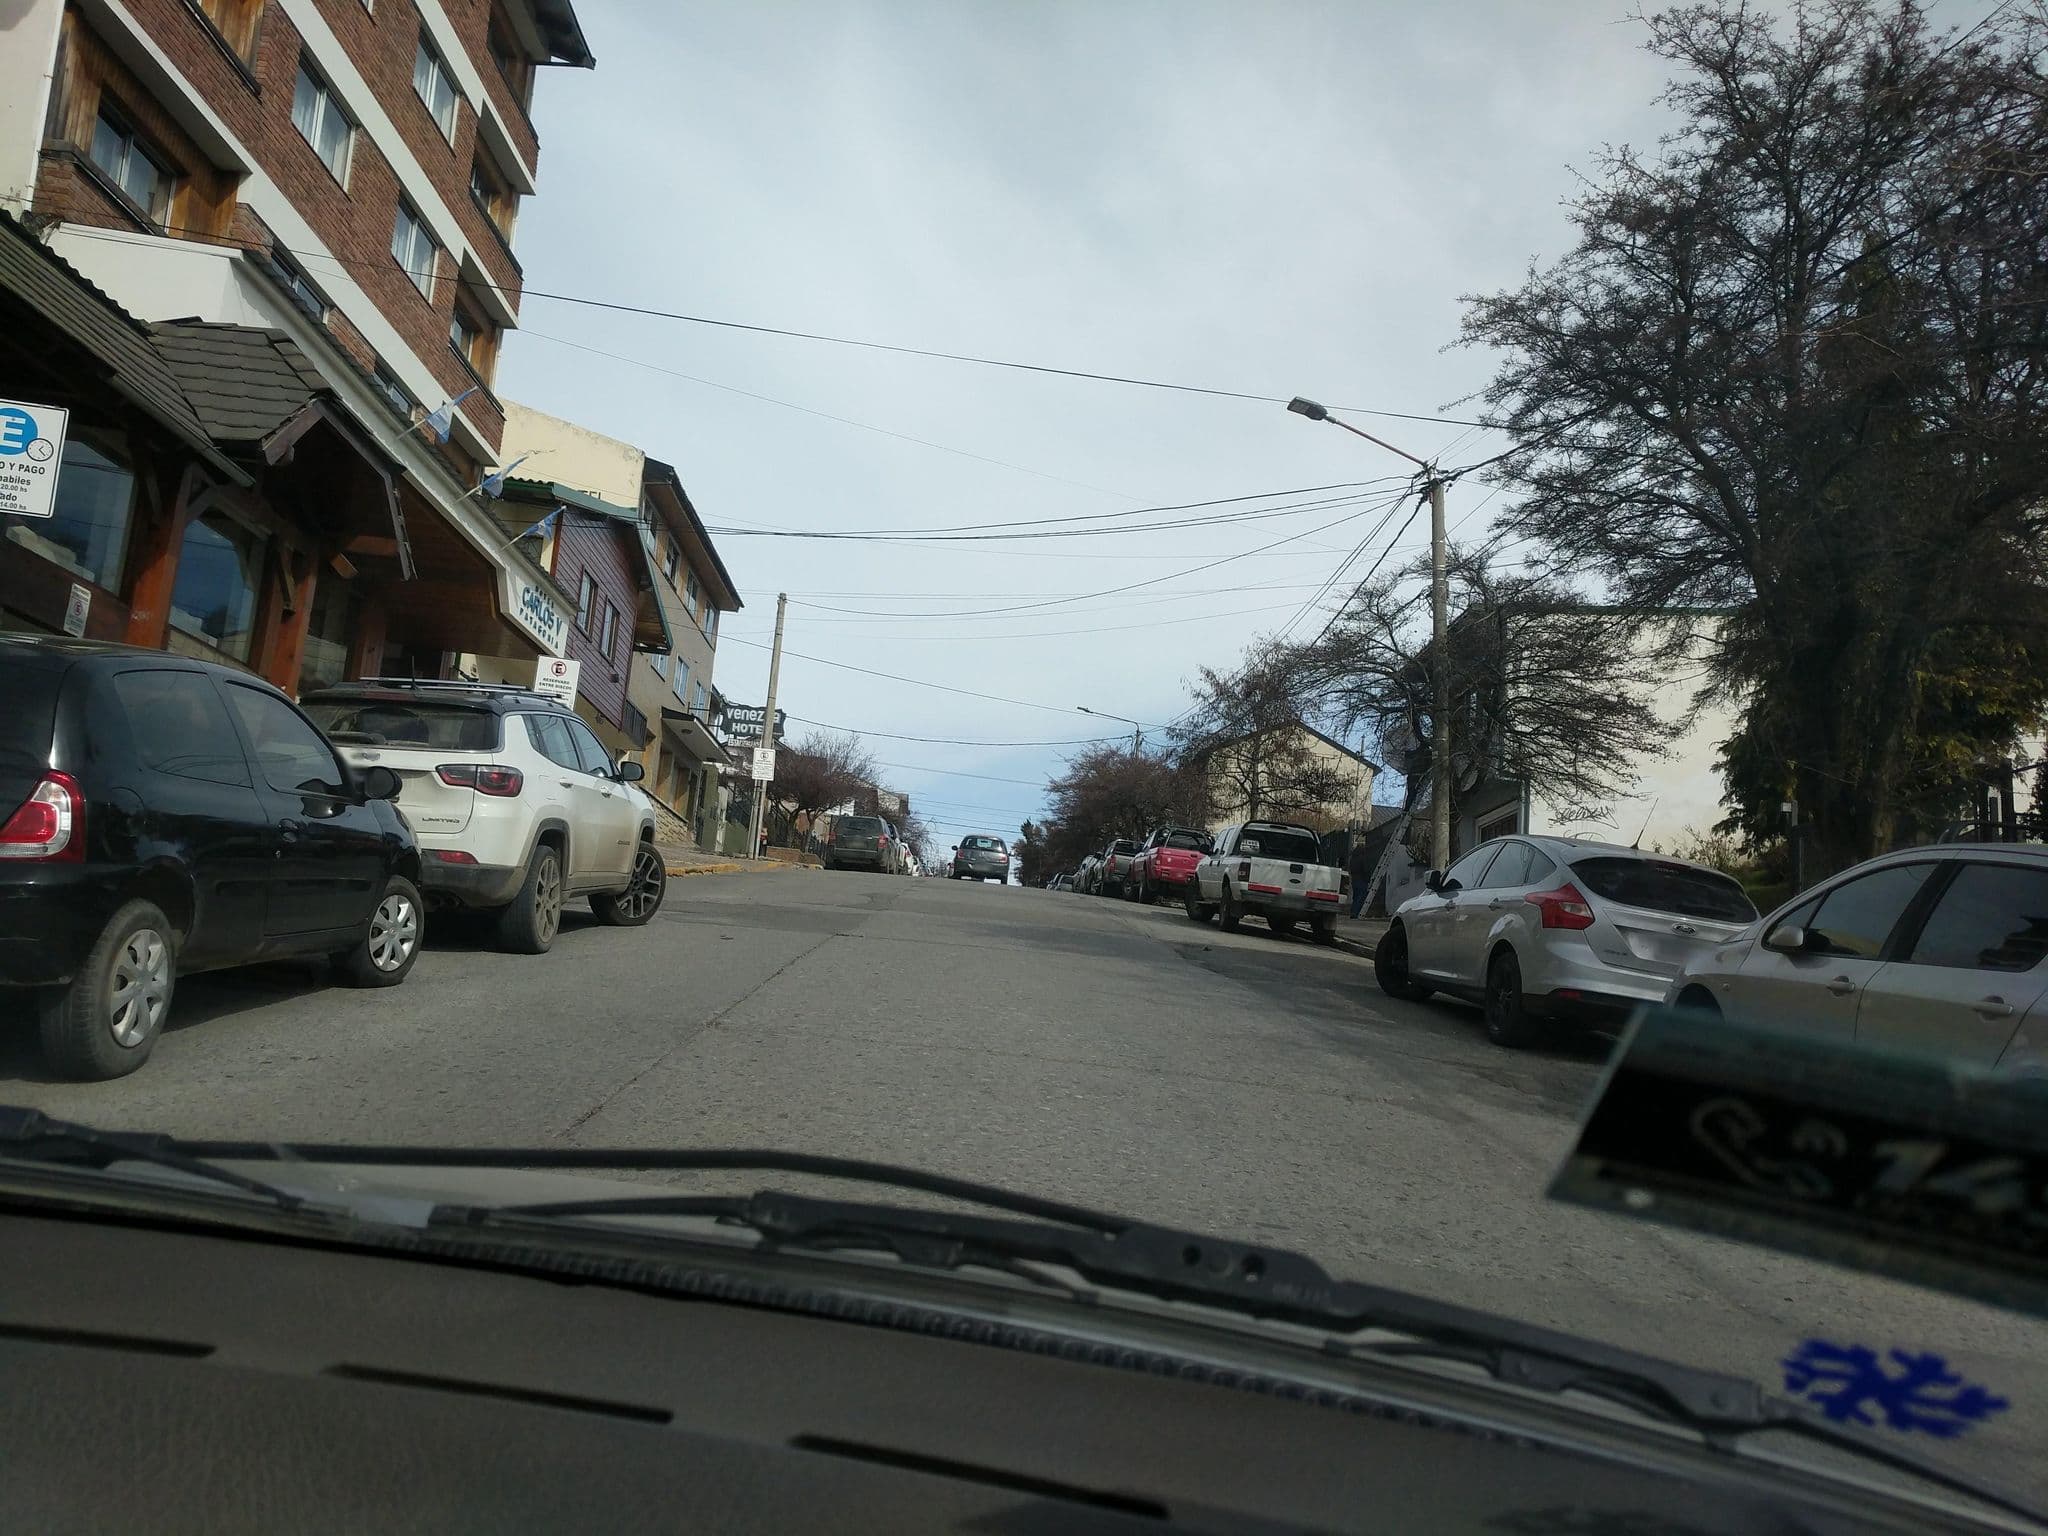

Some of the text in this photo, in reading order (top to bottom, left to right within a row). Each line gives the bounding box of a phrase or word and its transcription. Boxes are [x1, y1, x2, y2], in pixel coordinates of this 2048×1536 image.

[9, 462, 16, 471] Y
[18, 464, 45, 475] PAGO
[522, 586, 563, 636] CARLOS V
[519, 607, 559, 650] PATAGONIA
[727, 707, 781, 723] veneza
[732, 722, 765, 734] HOTE
